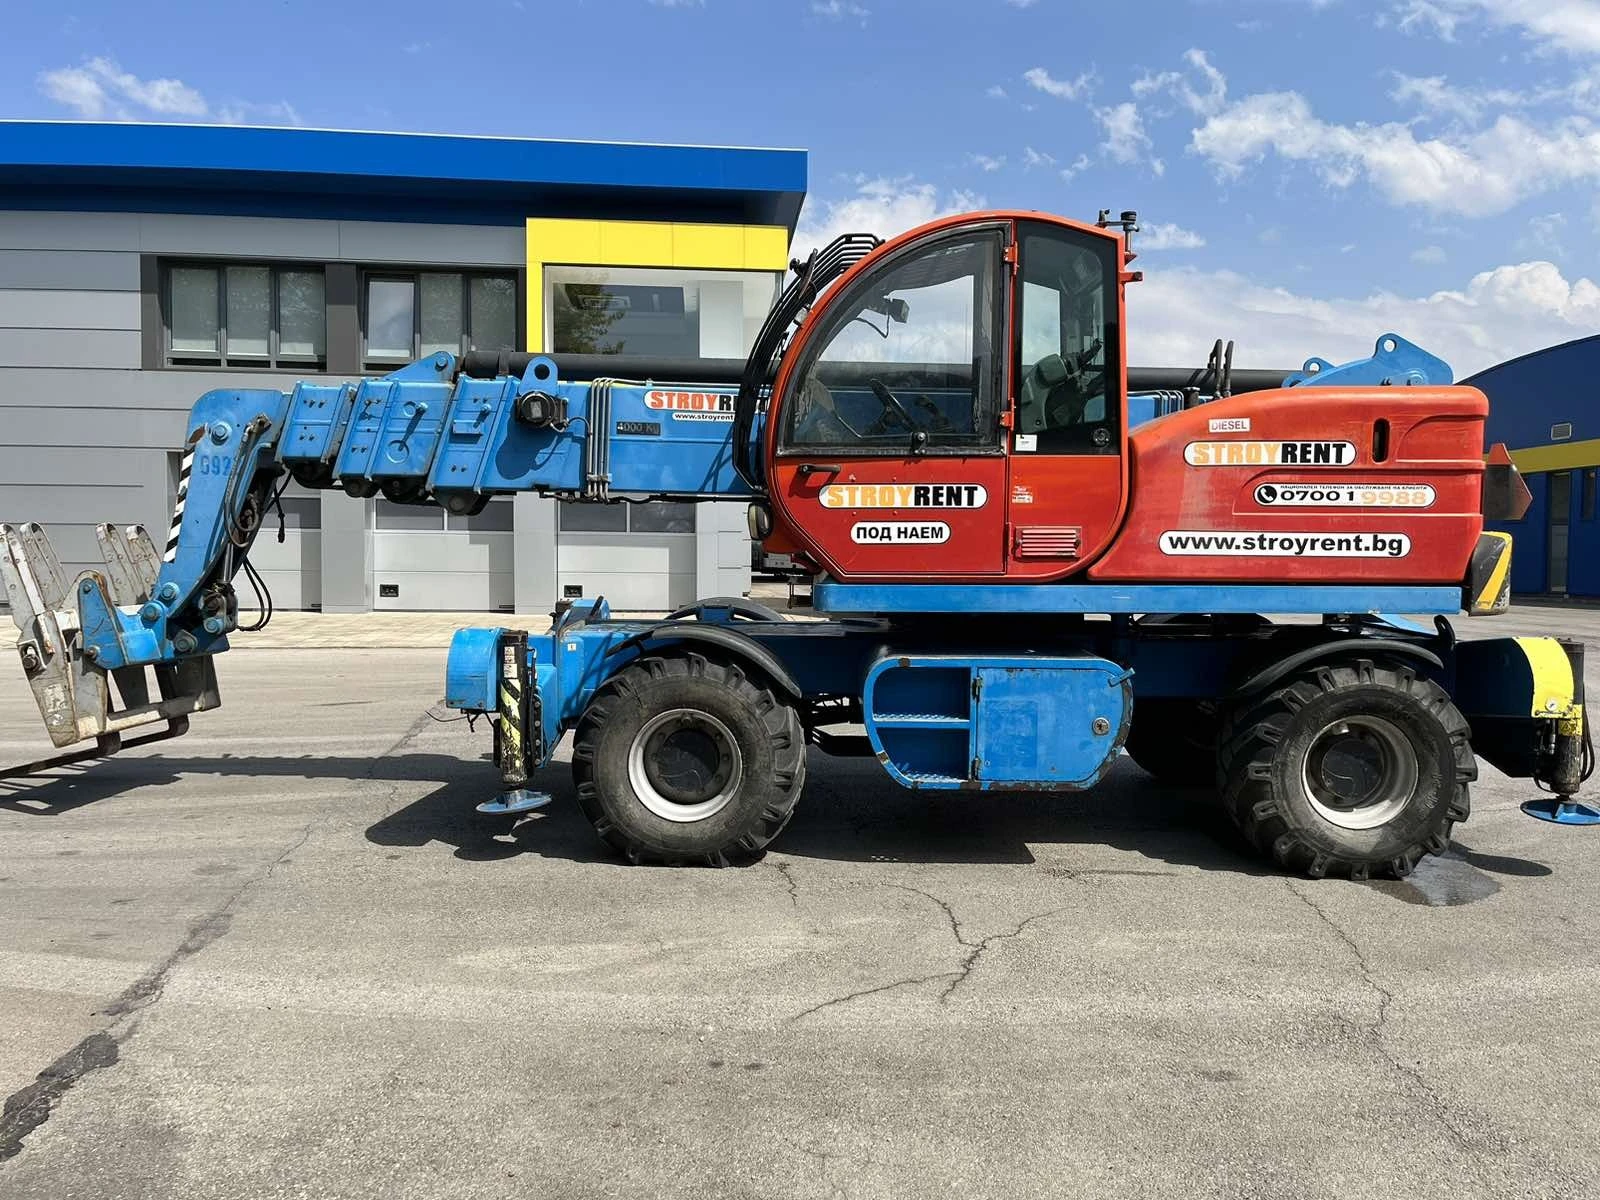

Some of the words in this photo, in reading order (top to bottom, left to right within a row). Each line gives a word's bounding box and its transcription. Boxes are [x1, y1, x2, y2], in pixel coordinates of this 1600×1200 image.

[650, 391, 738, 411] STROYR
[675, 412, 734, 422] www.stroyrent
[1211, 420, 1248, 431] DIESEL
[1193, 443, 1347, 464] STROYRENT
[827, 486, 978, 507] STROYRENT
[1280, 490, 1341, 501] 0700
[1346, 490, 1354, 502] 1
[1360, 491, 1427, 505] 9988
[856, 526, 892, 541] ПОД
[897, 526, 944, 539] НАЕМ
[1168, 534, 1403, 556] www.stroyrent.bg
